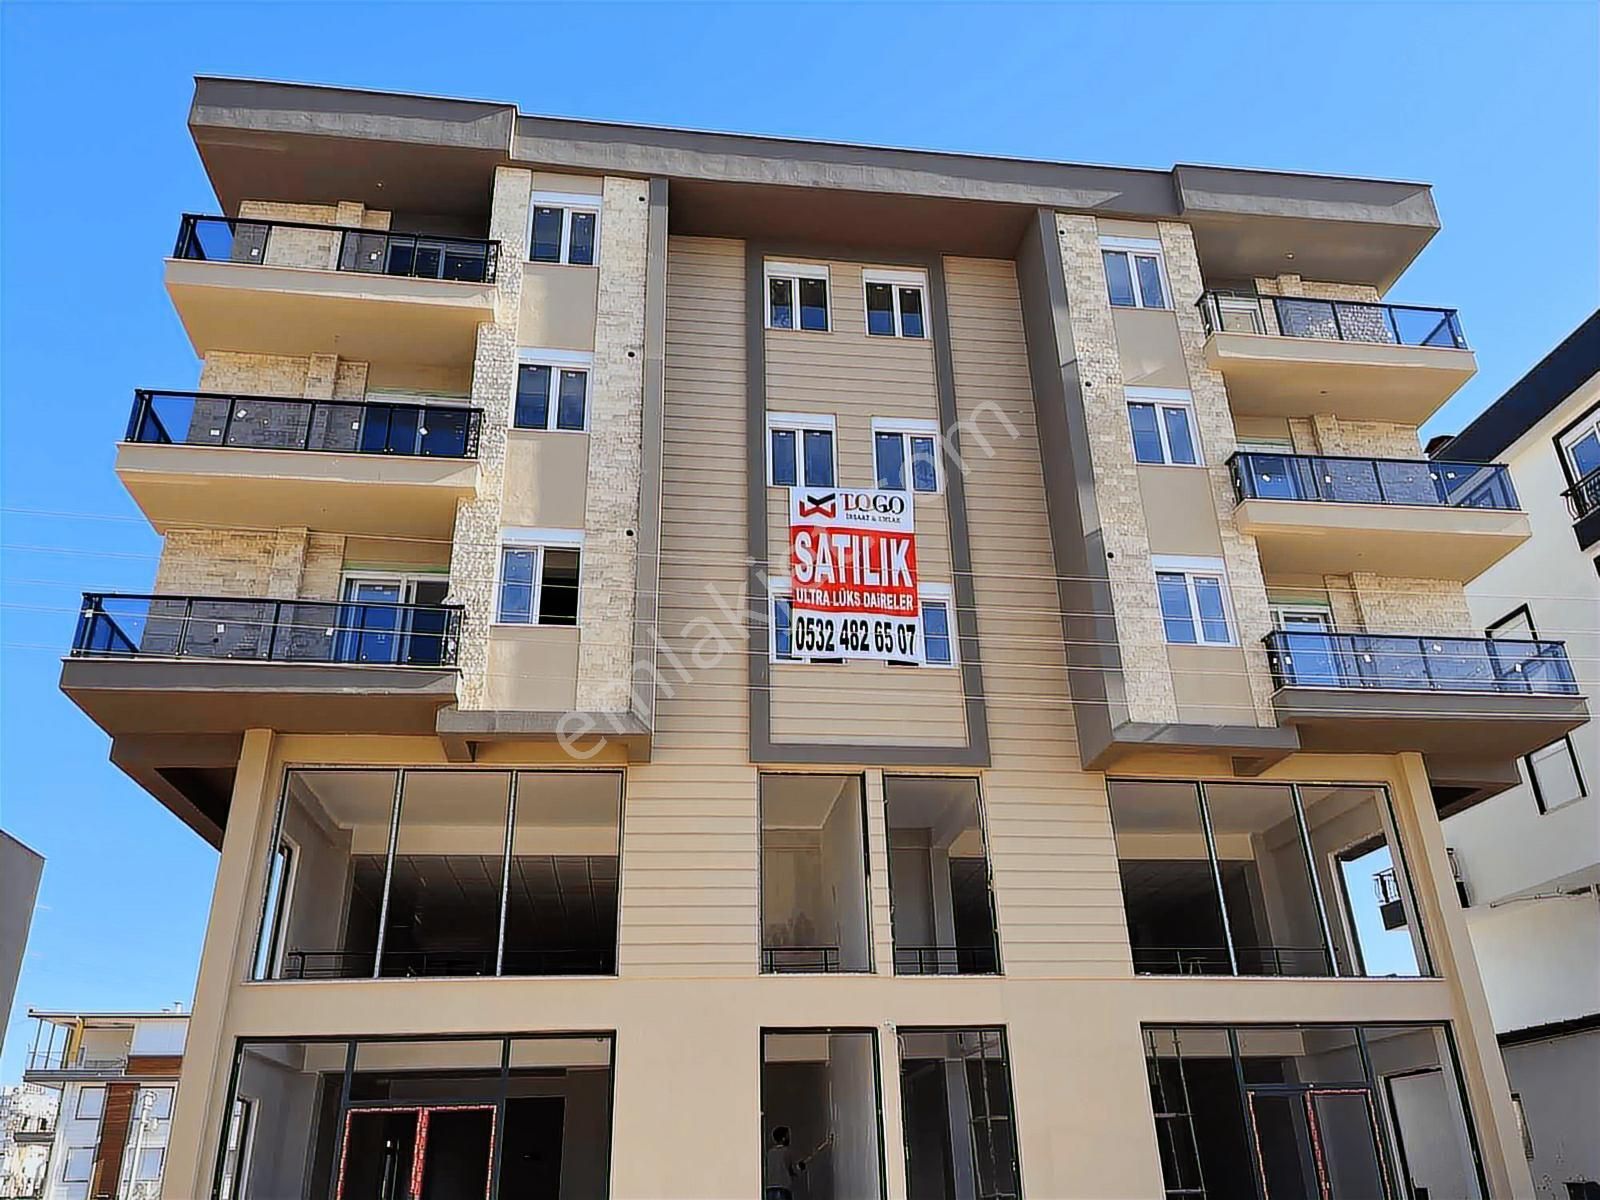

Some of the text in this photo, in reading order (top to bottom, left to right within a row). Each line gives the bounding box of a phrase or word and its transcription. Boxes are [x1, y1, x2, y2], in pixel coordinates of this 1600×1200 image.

[795, 531, 913, 588] SATILIK
[796, 588, 914, 611] ULTRA LÜKS DAİRELER
[795, 616, 916, 655] 0532 482 65 07
